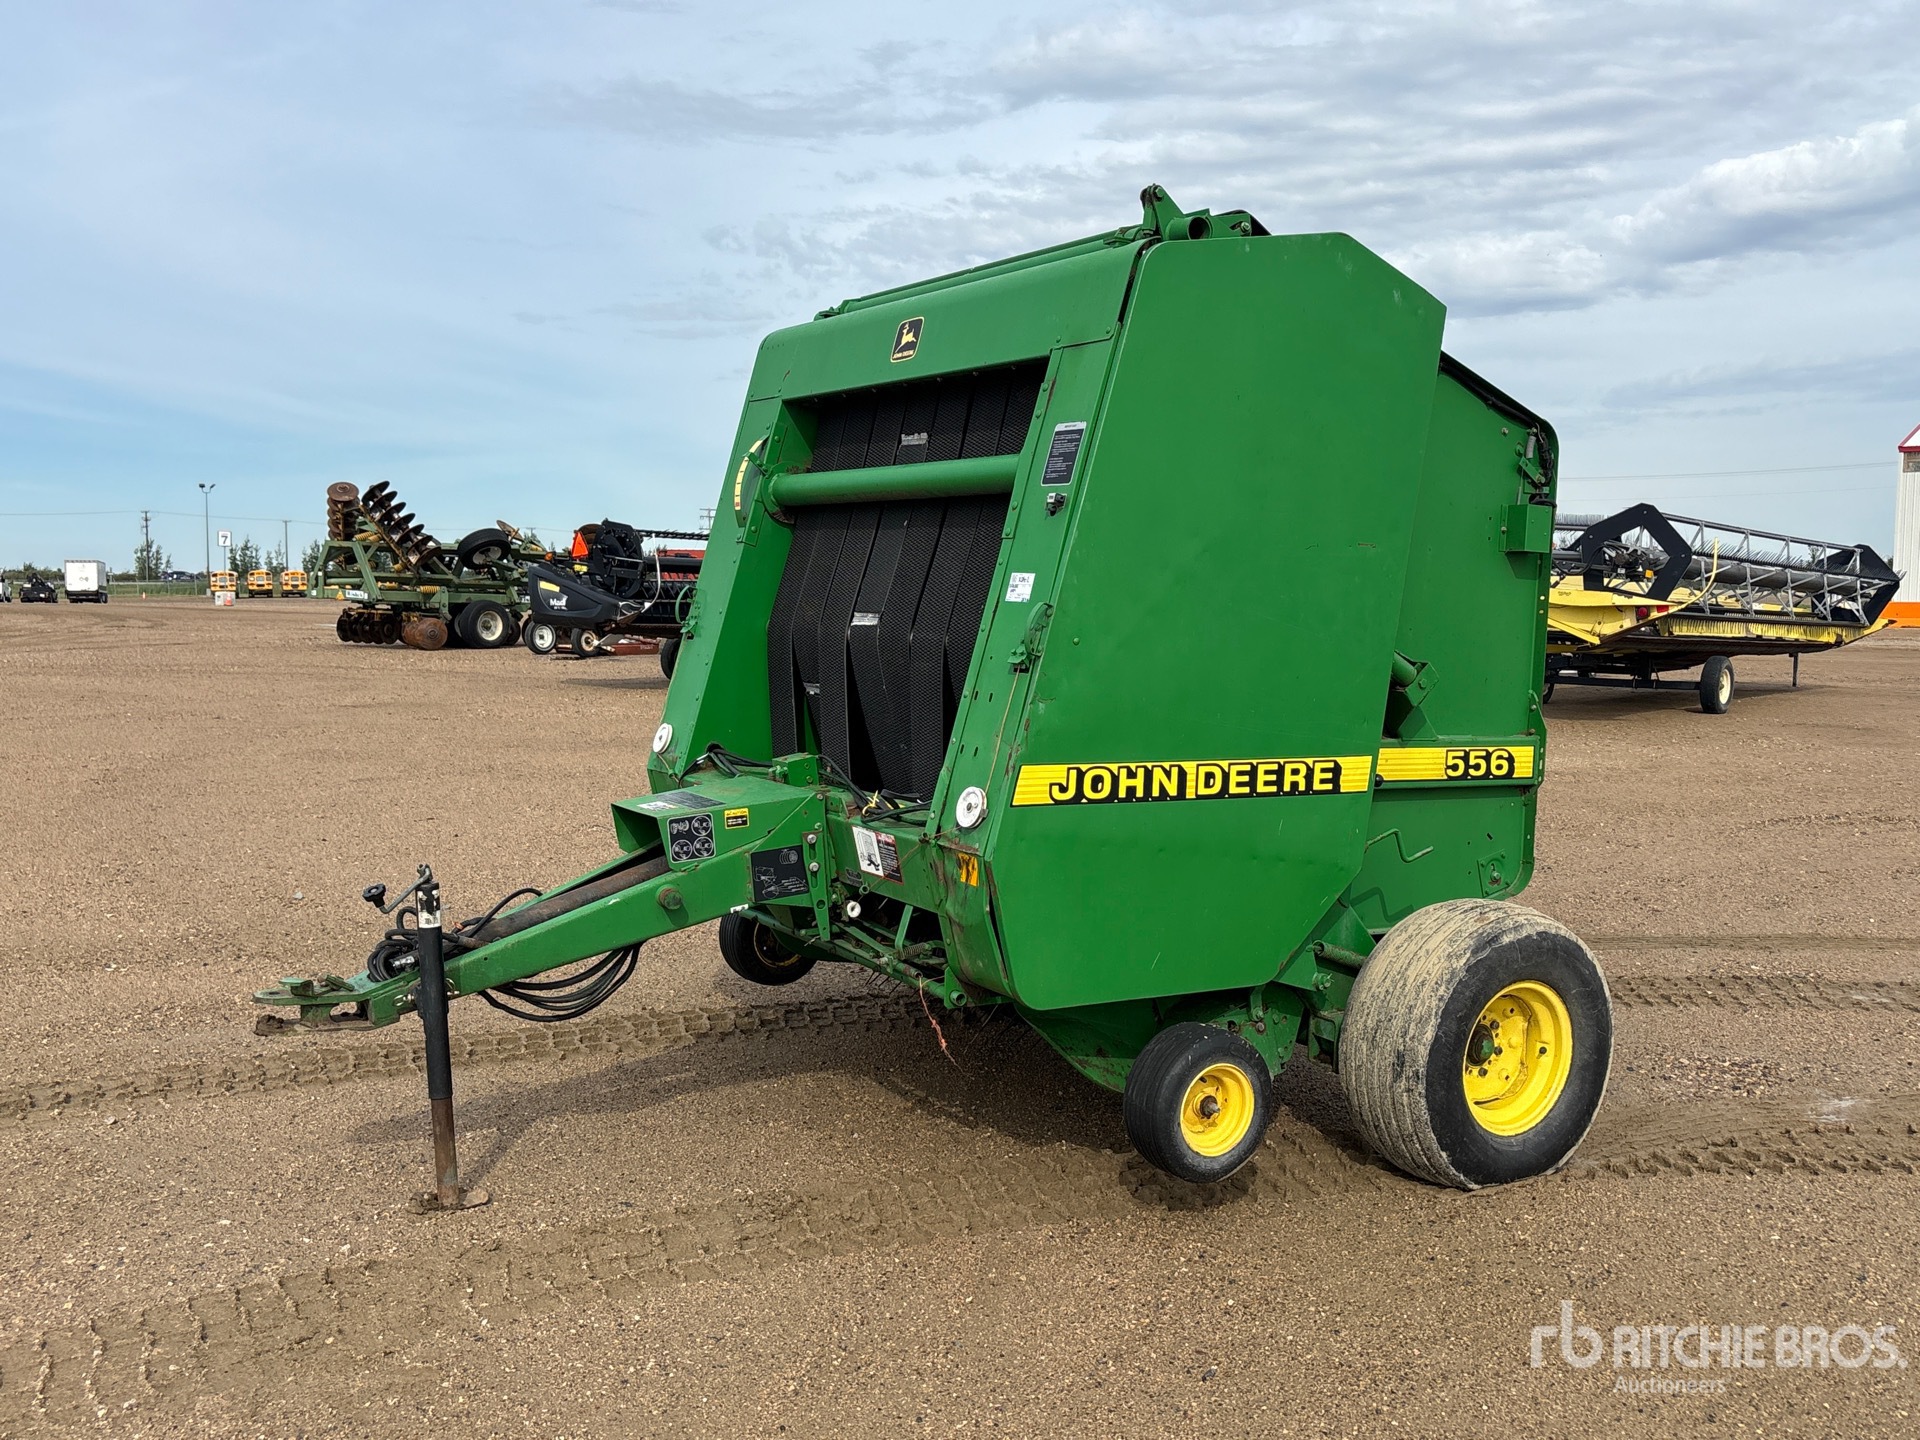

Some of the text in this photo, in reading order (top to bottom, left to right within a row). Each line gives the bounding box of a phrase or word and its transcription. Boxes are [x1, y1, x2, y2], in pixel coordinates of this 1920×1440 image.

[221, 535, 228, 545] 7
[1446, 748, 1514, 779] 556
[1050, 760, 1341, 803] JOHN DEERE
